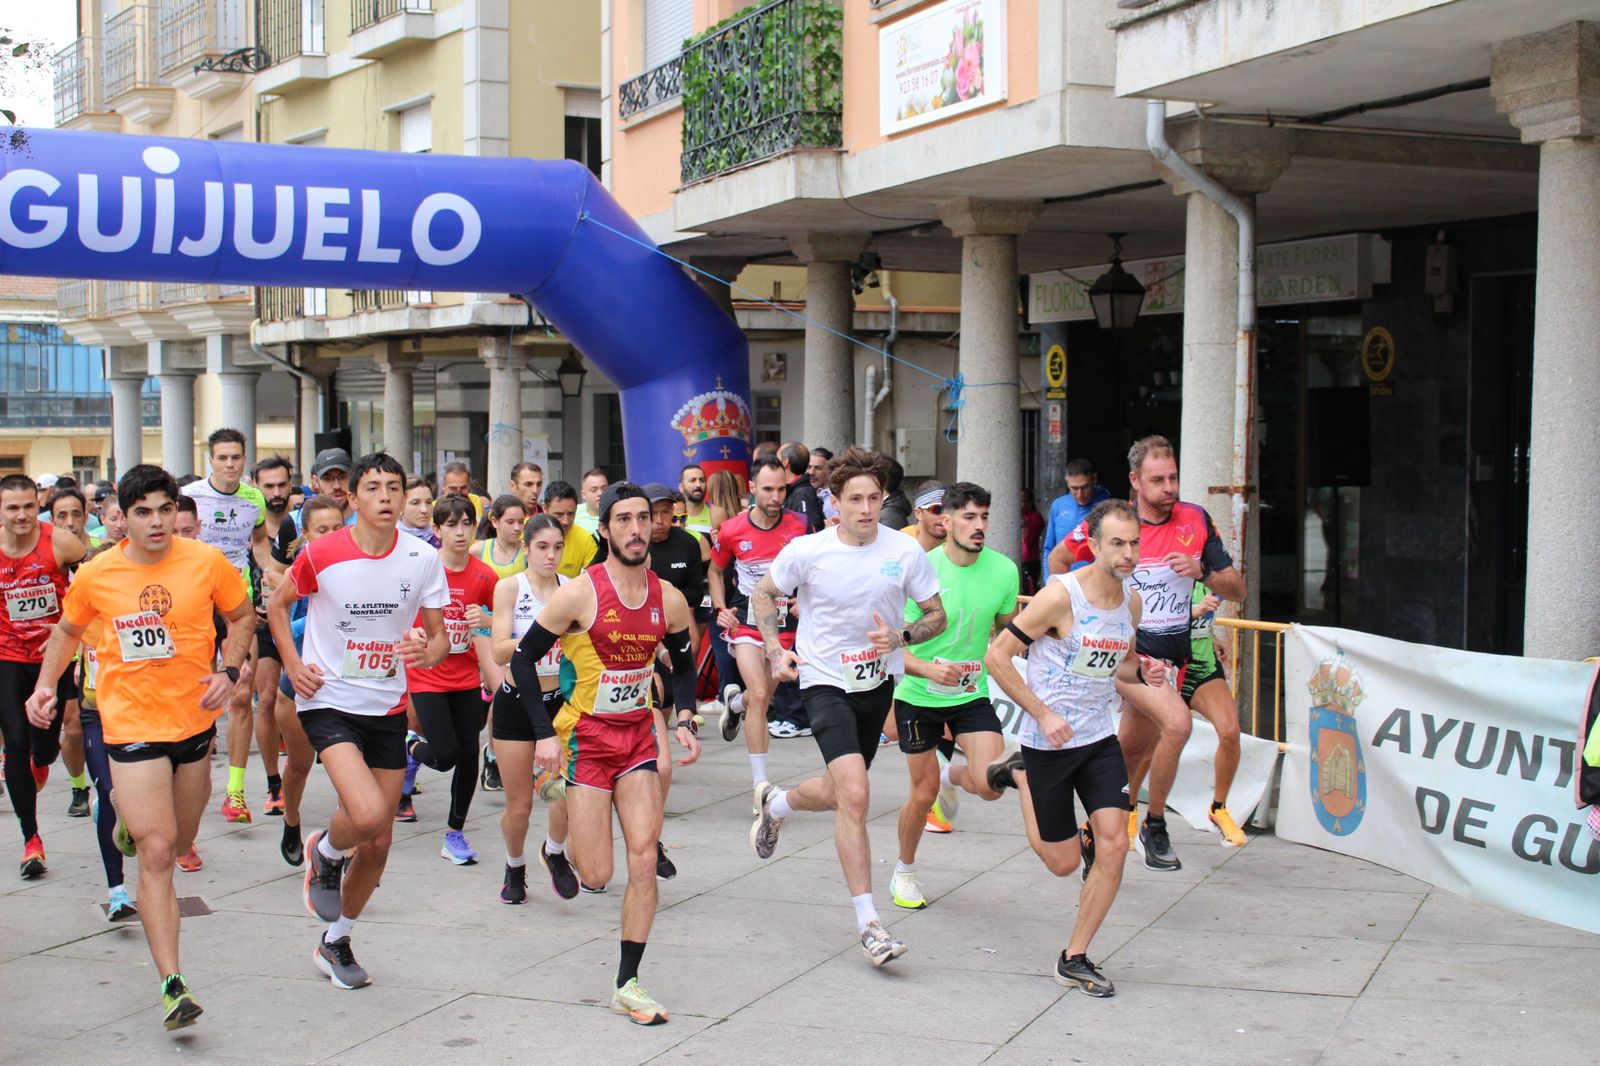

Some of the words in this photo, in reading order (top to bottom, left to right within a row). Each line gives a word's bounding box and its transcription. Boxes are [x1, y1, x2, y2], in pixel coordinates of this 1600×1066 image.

[1257, 250, 1290, 269] ARTE
[1295, 243, 1347, 266] FLORAL
[1260, 275, 1342, 299] GARDEN
[1129, 569, 1170, 593] Simón
[6, 586, 55, 601] bedunia
[18, 597, 48, 612] 270
[350, 608, 393, 616] MONFRAGÜE
[115, 615, 161, 631] bedun
[132, 628, 166, 648] 309
[346, 639, 394, 652] bedun
[1082, 635, 1129, 651] bedunia
[620, 645, 645, 654] VINO
[358, 653, 393, 670] 105
[610, 654, 623, 662] DE
[1087, 651, 1117, 669] 276
[601, 669, 653, 685] bedunia
[854, 659, 881, 680] 272
[610, 683, 640, 703] 326
[1415, 785, 1497, 849] DE
